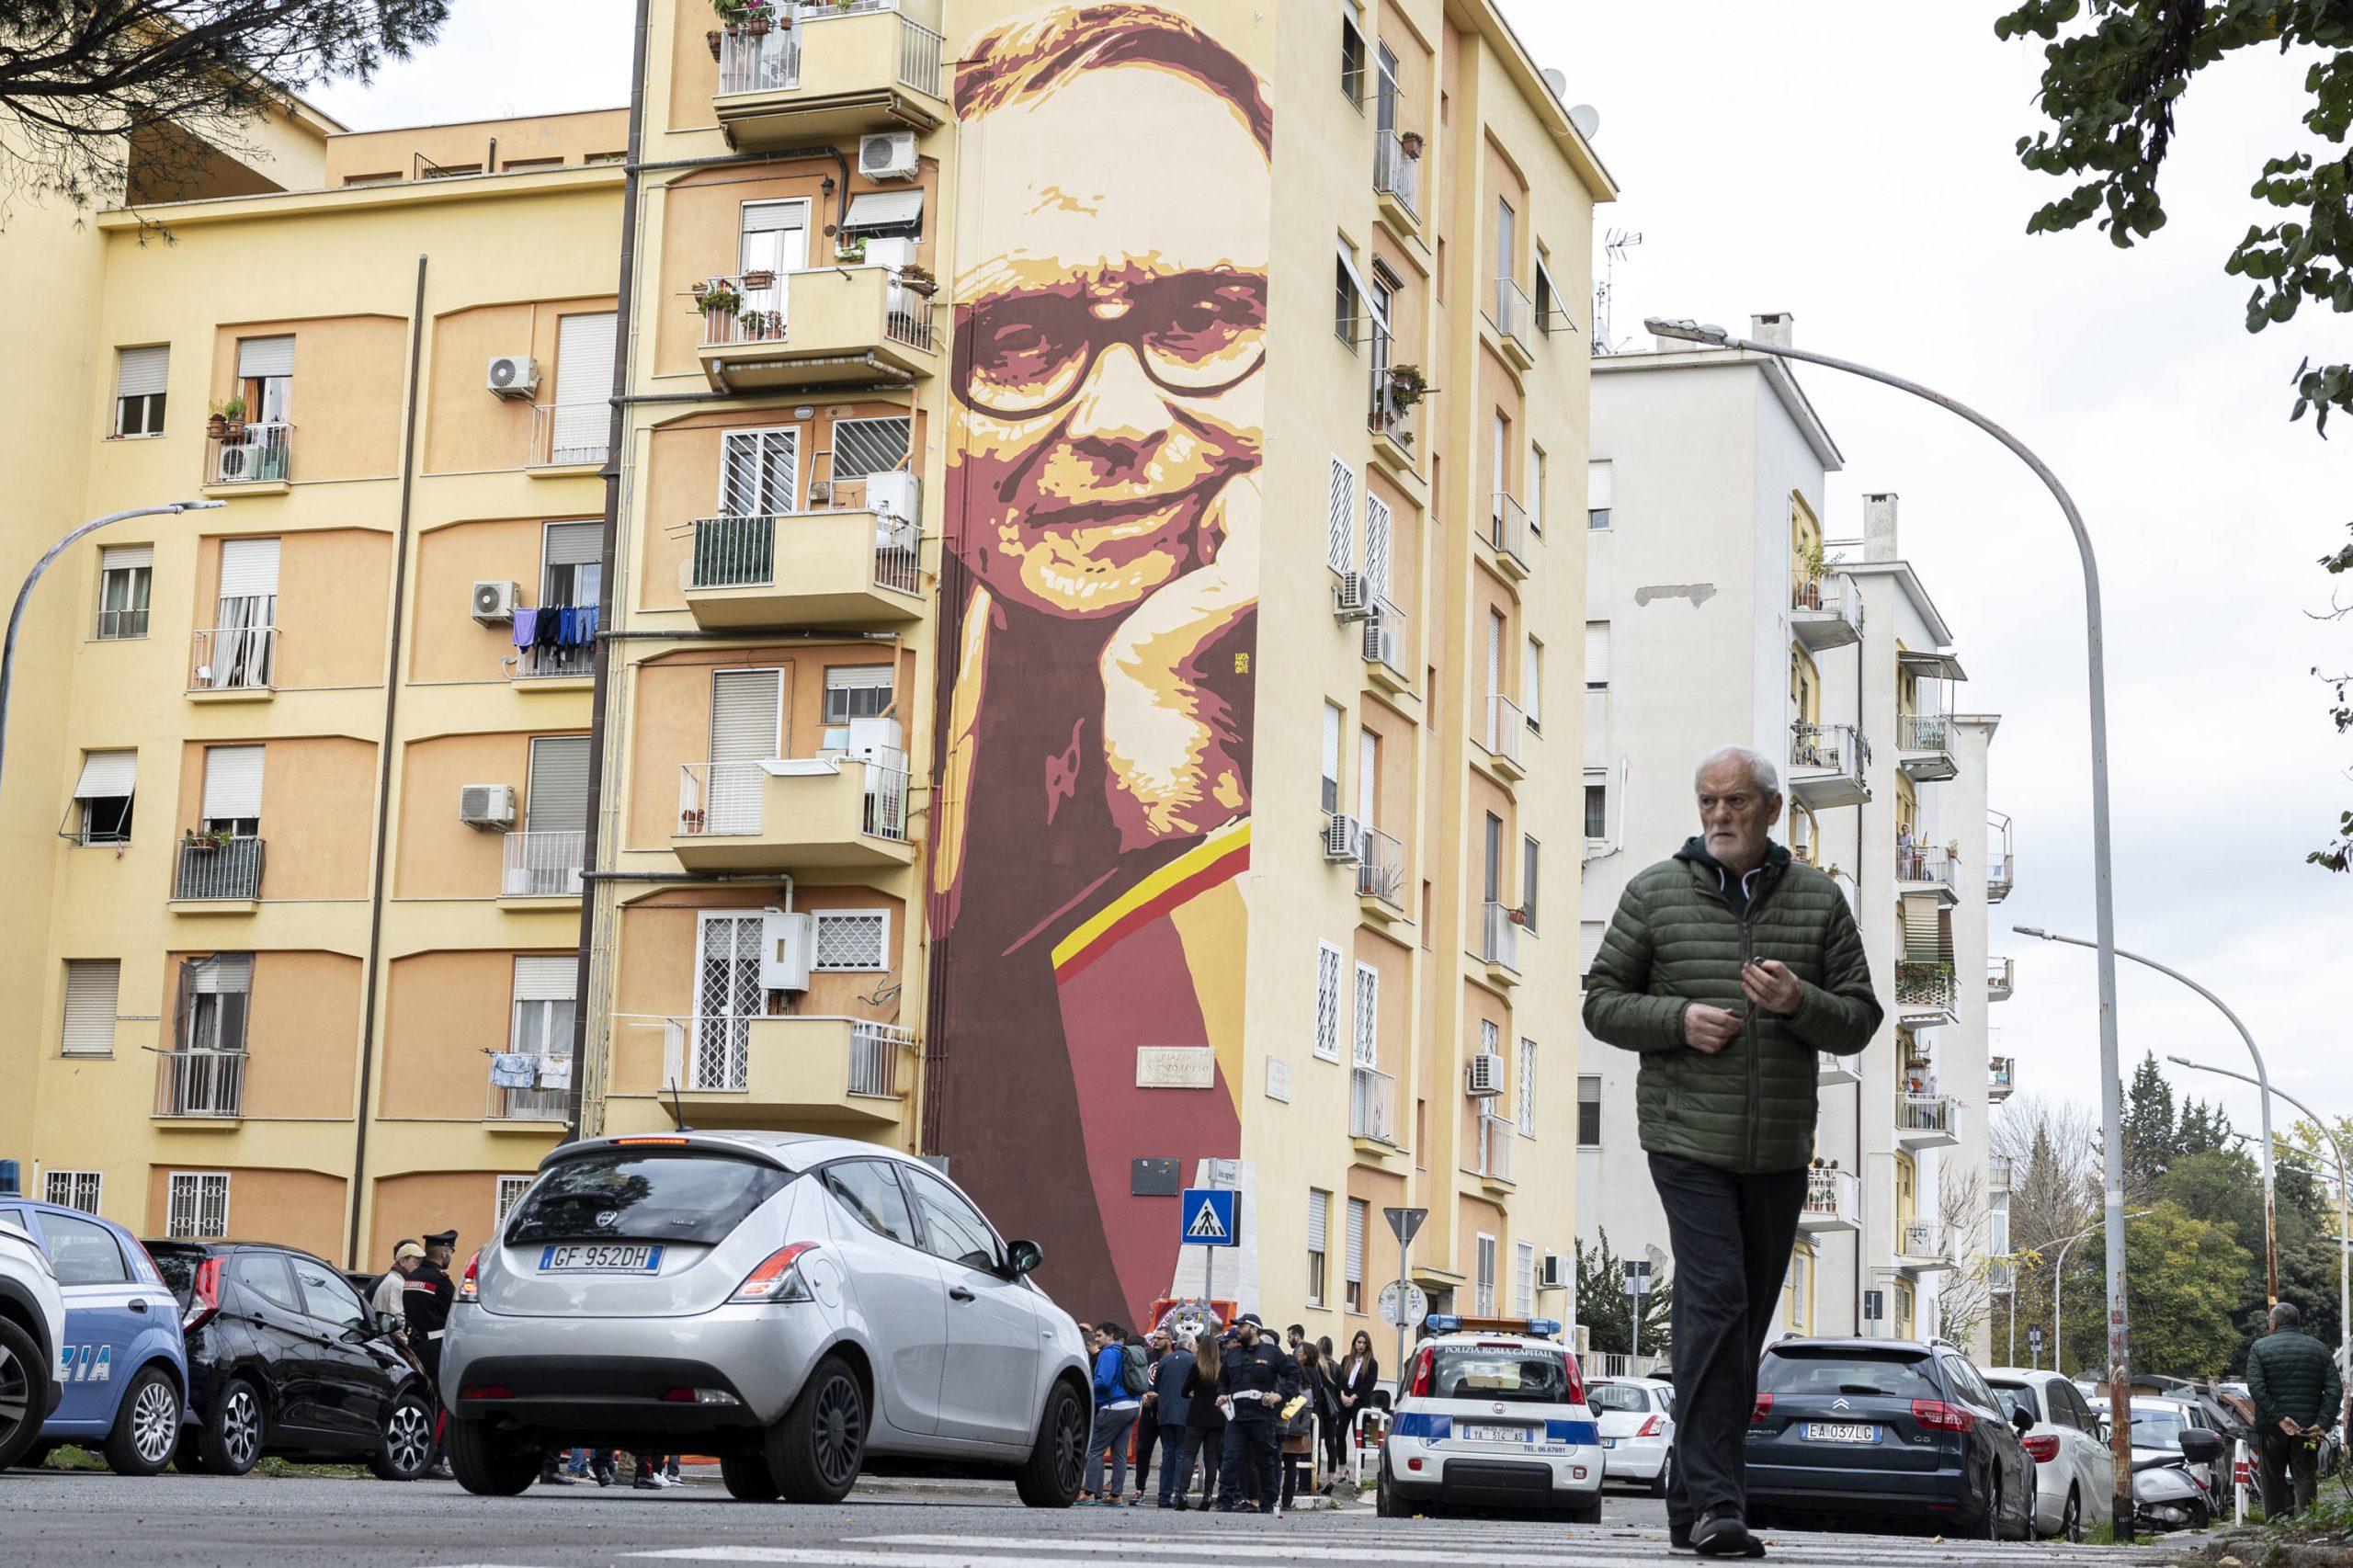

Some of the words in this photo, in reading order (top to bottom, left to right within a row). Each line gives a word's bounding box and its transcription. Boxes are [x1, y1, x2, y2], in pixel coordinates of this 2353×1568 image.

[554, 1247, 580, 1267] GF
[585, 1246, 648, 1267] 952DH
[1445, 1346, 1481, 1354] POLIZIA
[1514, 1349, 1554, 1358] CAPITALE
[1492, 1432, 1506, 1440] 314
[1515, 1433, 1523, 1441] AS
[1810, 1425, 1825, 1437] EA
[1830, 1425, 1871, 1439] 037LG
